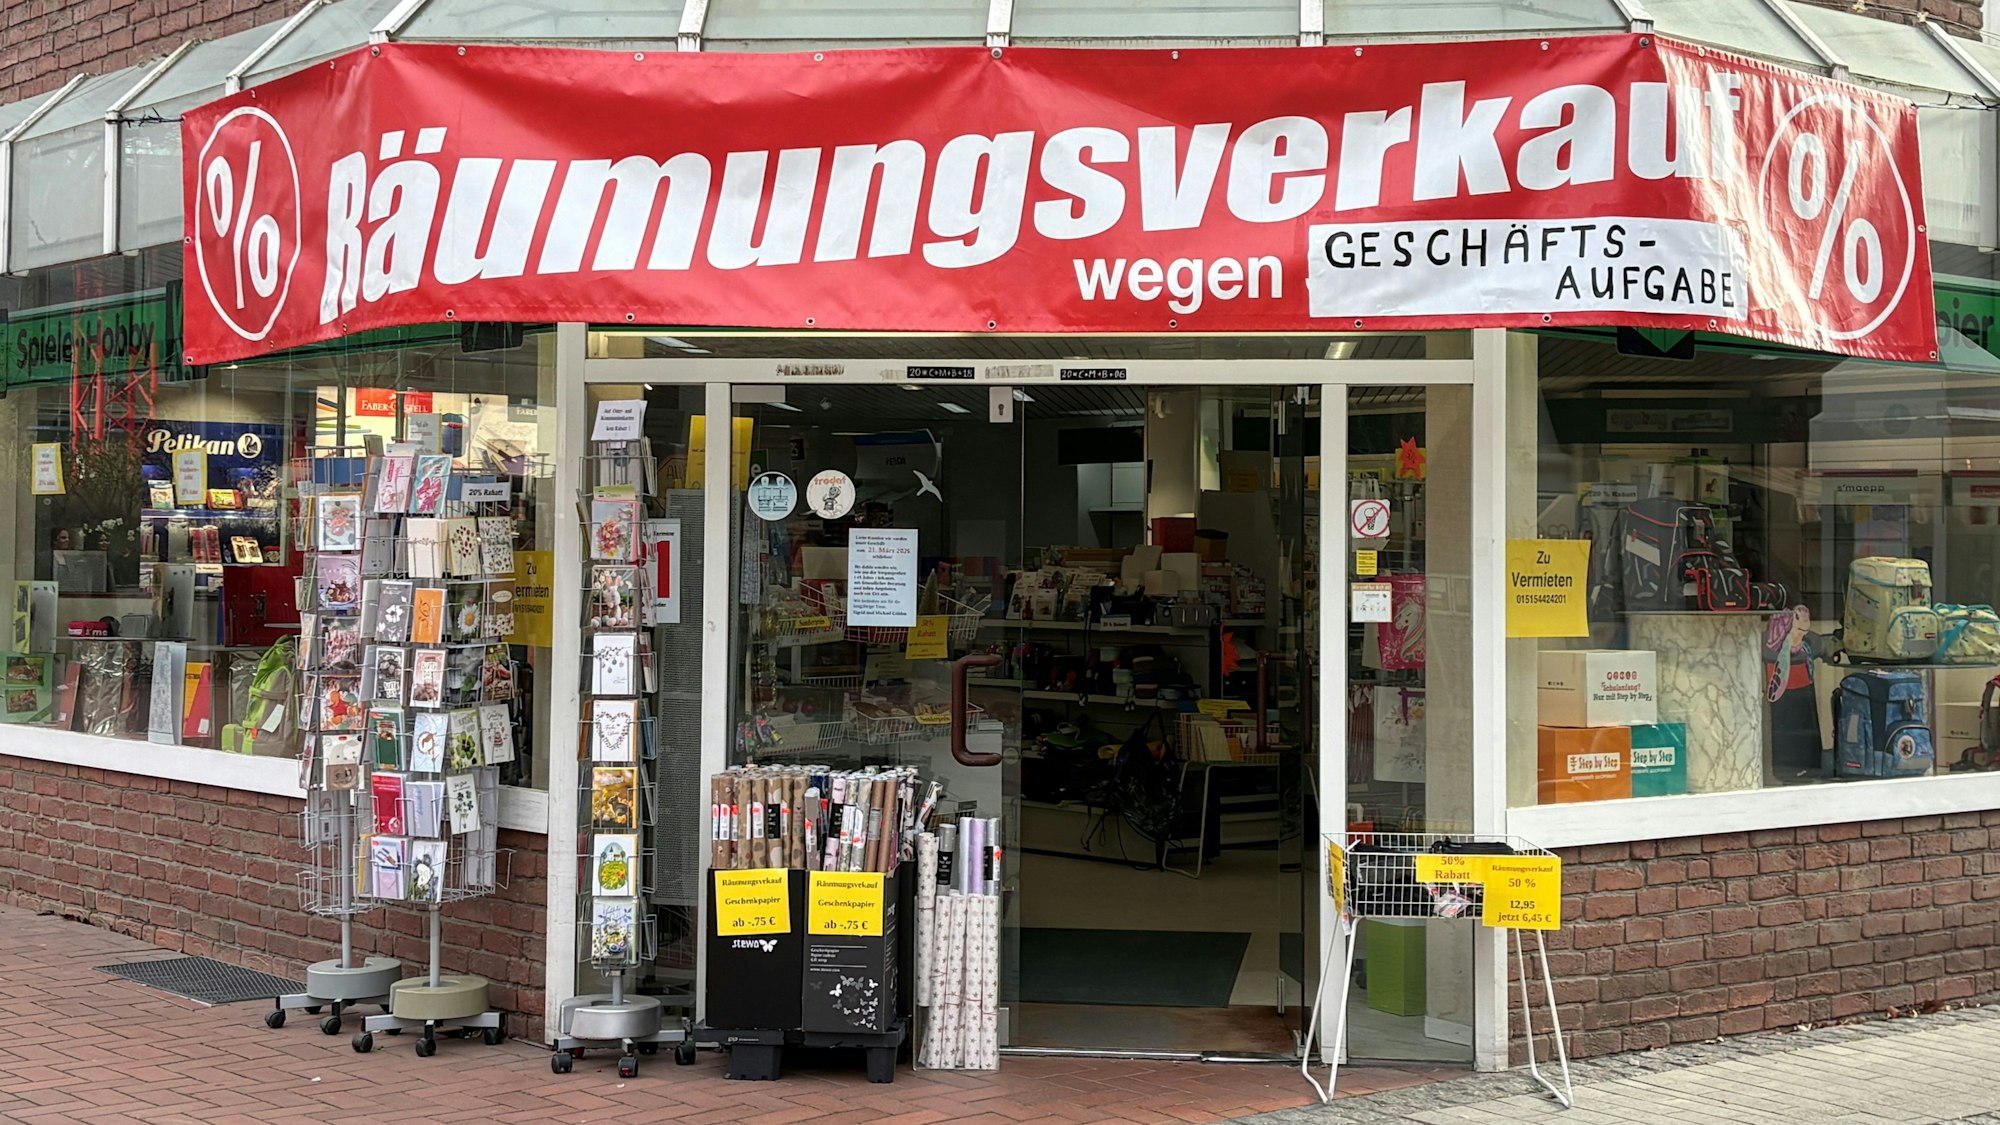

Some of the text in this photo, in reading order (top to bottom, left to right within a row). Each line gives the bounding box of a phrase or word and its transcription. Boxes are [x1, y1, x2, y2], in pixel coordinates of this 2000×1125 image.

[319, 73, 1742, 324] Räumungsverkauf
[1324, 223, 1656, 269] GESCHÄFTS-
[1073, 256, 1283, 314] wegen
[1555, 264, 1735, 308] AUFGABE
[146, 429, 235, 456] Pelikan
[814, 476, 847, 485] trodat
[468, 489, 504, 497] 20% Rabatt
[1536, 550, 1551, 564] Zu
[527, 562, 537, 575] Zu
[1511, 572, 1573, 587] Vermieten
[515, 584, 550, 599] ermieten
[1516, 594, 1567, 604] 015154424201
[1633, 750, 1673, 763] Step by Step
[1578, 755, 1618, 770] Step by Step
[1441, 856, 1465, 865] 50%
[1435, 870, 1470, 879] Rabatt
[1508, 878, 1536, 888] 50 %
[725, 896, 781, 906] Geschenkpapier
[818, 899, 875, 909] Geschenkpapier
[1510, 900, 1536, 910] 12,95
[732, 917, 745, 928] ab
[769, 917, 776, 926] €
[1498, 913, 1552, 923] jetzt 6,45 €
[824, 920, 837, 930] ab
[862, 921, 868, 930] €
